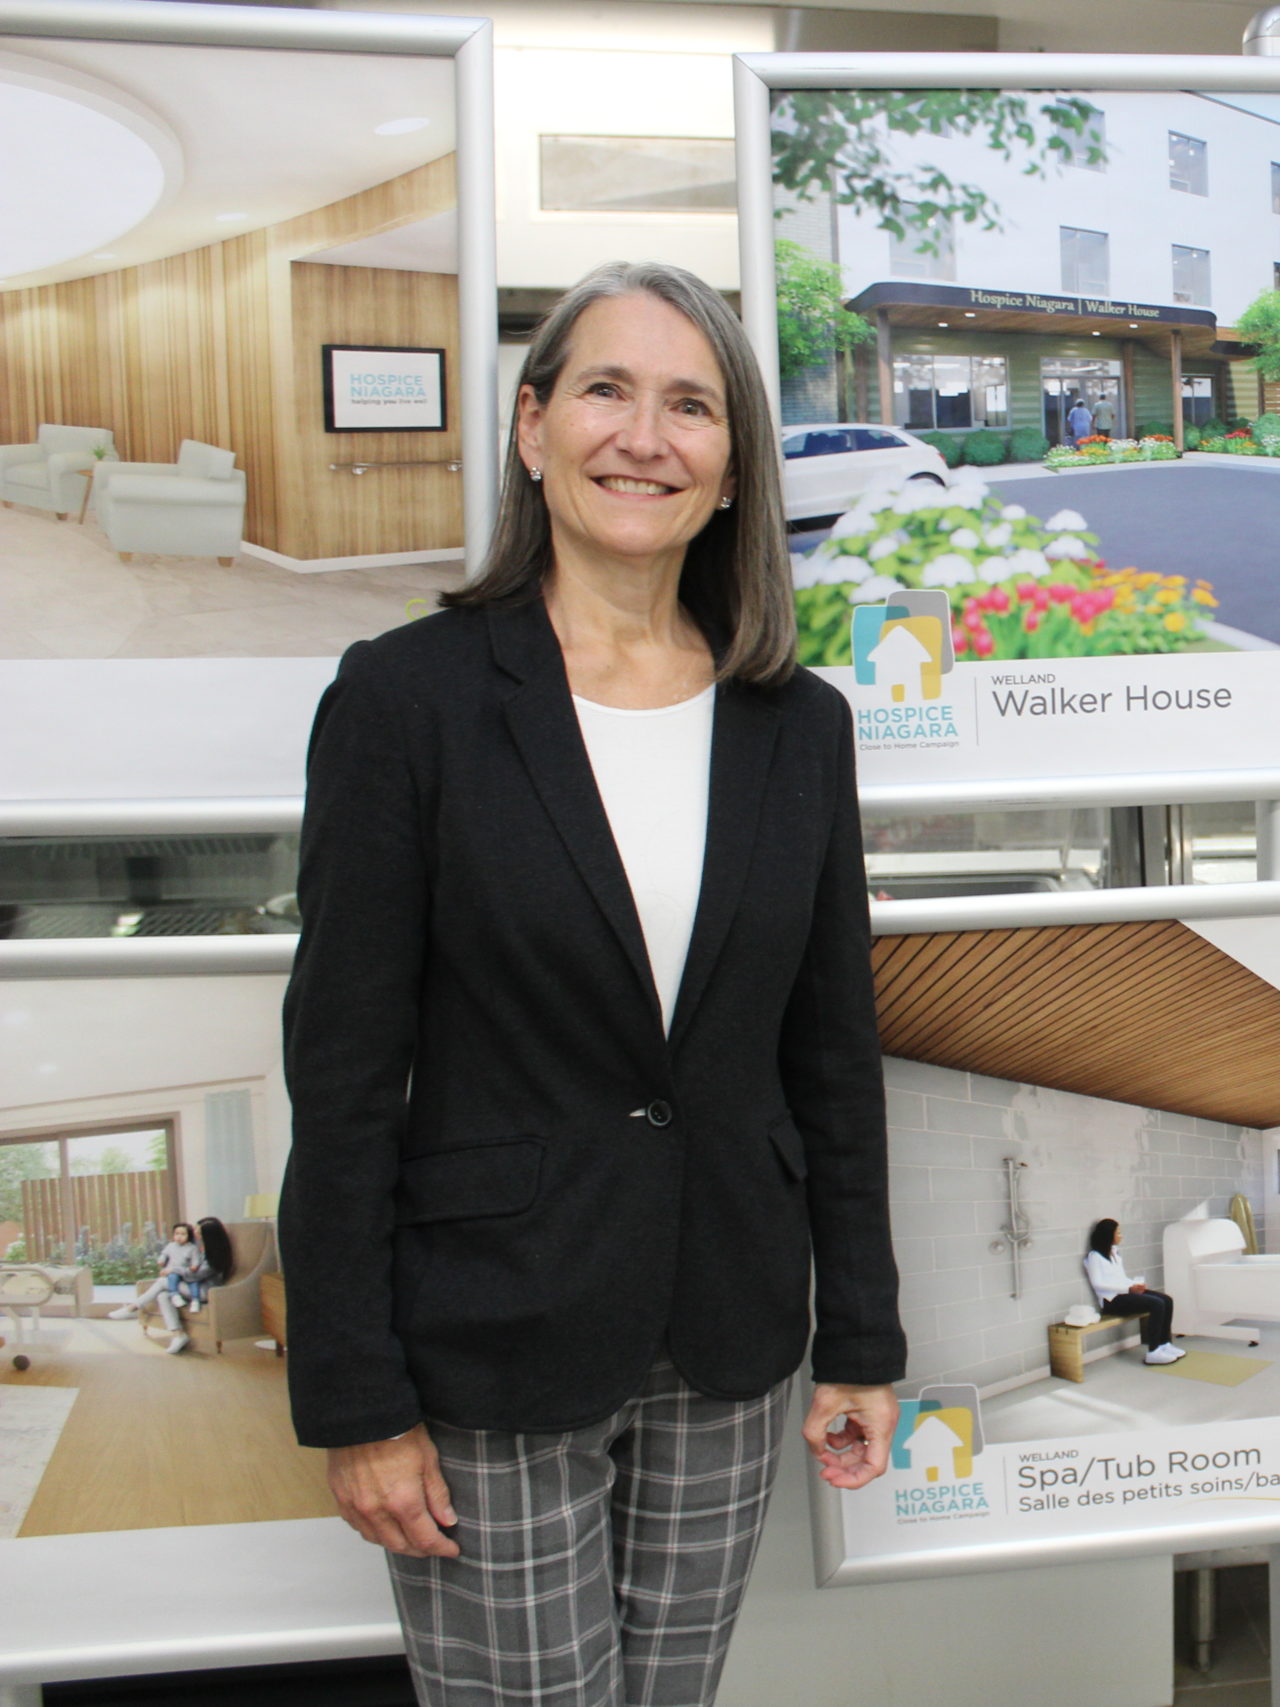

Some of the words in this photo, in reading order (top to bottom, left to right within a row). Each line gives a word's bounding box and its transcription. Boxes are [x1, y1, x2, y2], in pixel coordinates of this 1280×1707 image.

[970, 289, 1023, 309] Hospice
[1025, 293, 1075, 313] Niagara
[1085, 300, 1125, 315] Walker
[1128, 304, 1160, 318] House
[350, 374, 424, 385] HOSPICE
[350, 386, 427, 397] NIAGARA
[991, 674, 1056, 686] WELLAND
[992, 687, 1112, 717] Walker
[1125, 684, 1232, 712] House
[857, 705, 953, 724] HOSPICE
[858, 722, 959, 740] NIAGARA
[920, 741, 960, 749] Campaign
[1018, 1449, 1080, 1463] WELLAND
[1018, 1454, 1156, 1492] Spa/Tub
[1168, 1448, 1262, 1474] Room
[895, 1482, 984, 1503] HOSPICE
[1018, 1495, 1071, 1512] Salle
[1077, 1487, 1115, 1507] des
[1122, 1480, 1183, 1505] petits
[896, 1496, 990, 1516] NIAGARA
